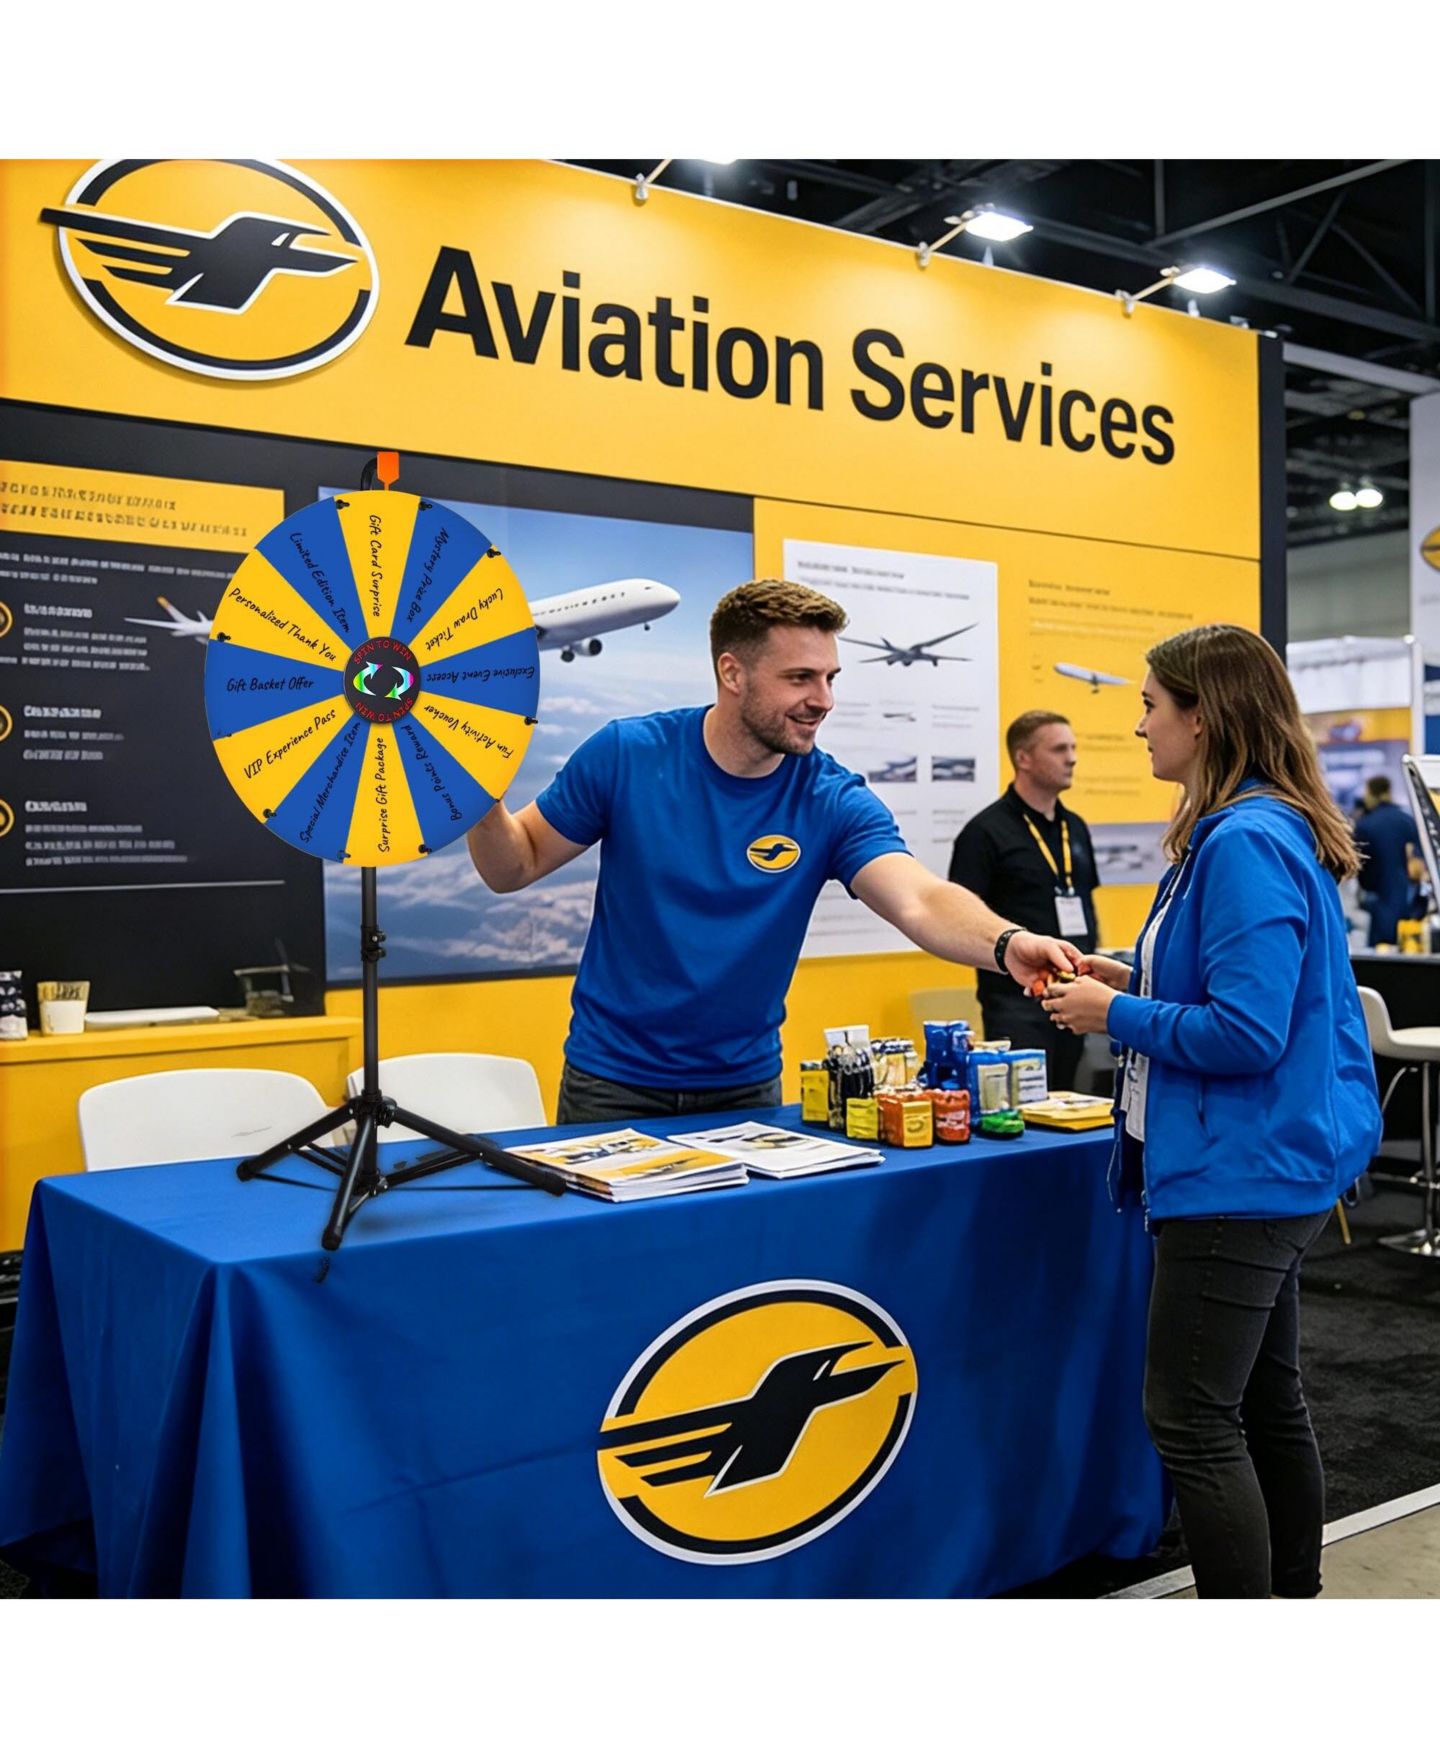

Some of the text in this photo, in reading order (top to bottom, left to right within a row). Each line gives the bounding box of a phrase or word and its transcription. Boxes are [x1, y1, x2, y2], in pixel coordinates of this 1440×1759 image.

[405, 246, 1175, 465] Aviation Services
[289, 532, 350, 634] Limited Edition Item
[369, 514, 383, 617] Gift Card Surprise
[406, 527, 450, 623] Mystery Prize Box
[228, 587, 337, 662] Personalized Thank You
[353, 640, 412, 665] SPIN TO WIN
[425, 588, 505, 651] Lucky Draw Ticket
[226, 676, 315, 692] Gift Basket Offer
[355, 697, 413, 721] SPIN TO WIN
[426, 666, 535, 683] Exclusive Event Access
[243, 709, 337, 779] VIP Experience Pass
[423, 706, 514, 759] Fun Activity Voucher
[299, 722, 362, 844] Special Merchandise Item
[374, 737, 391, 853] Surprise Gift Package
[400, 724, 463, 821] Bonus Points Reward
